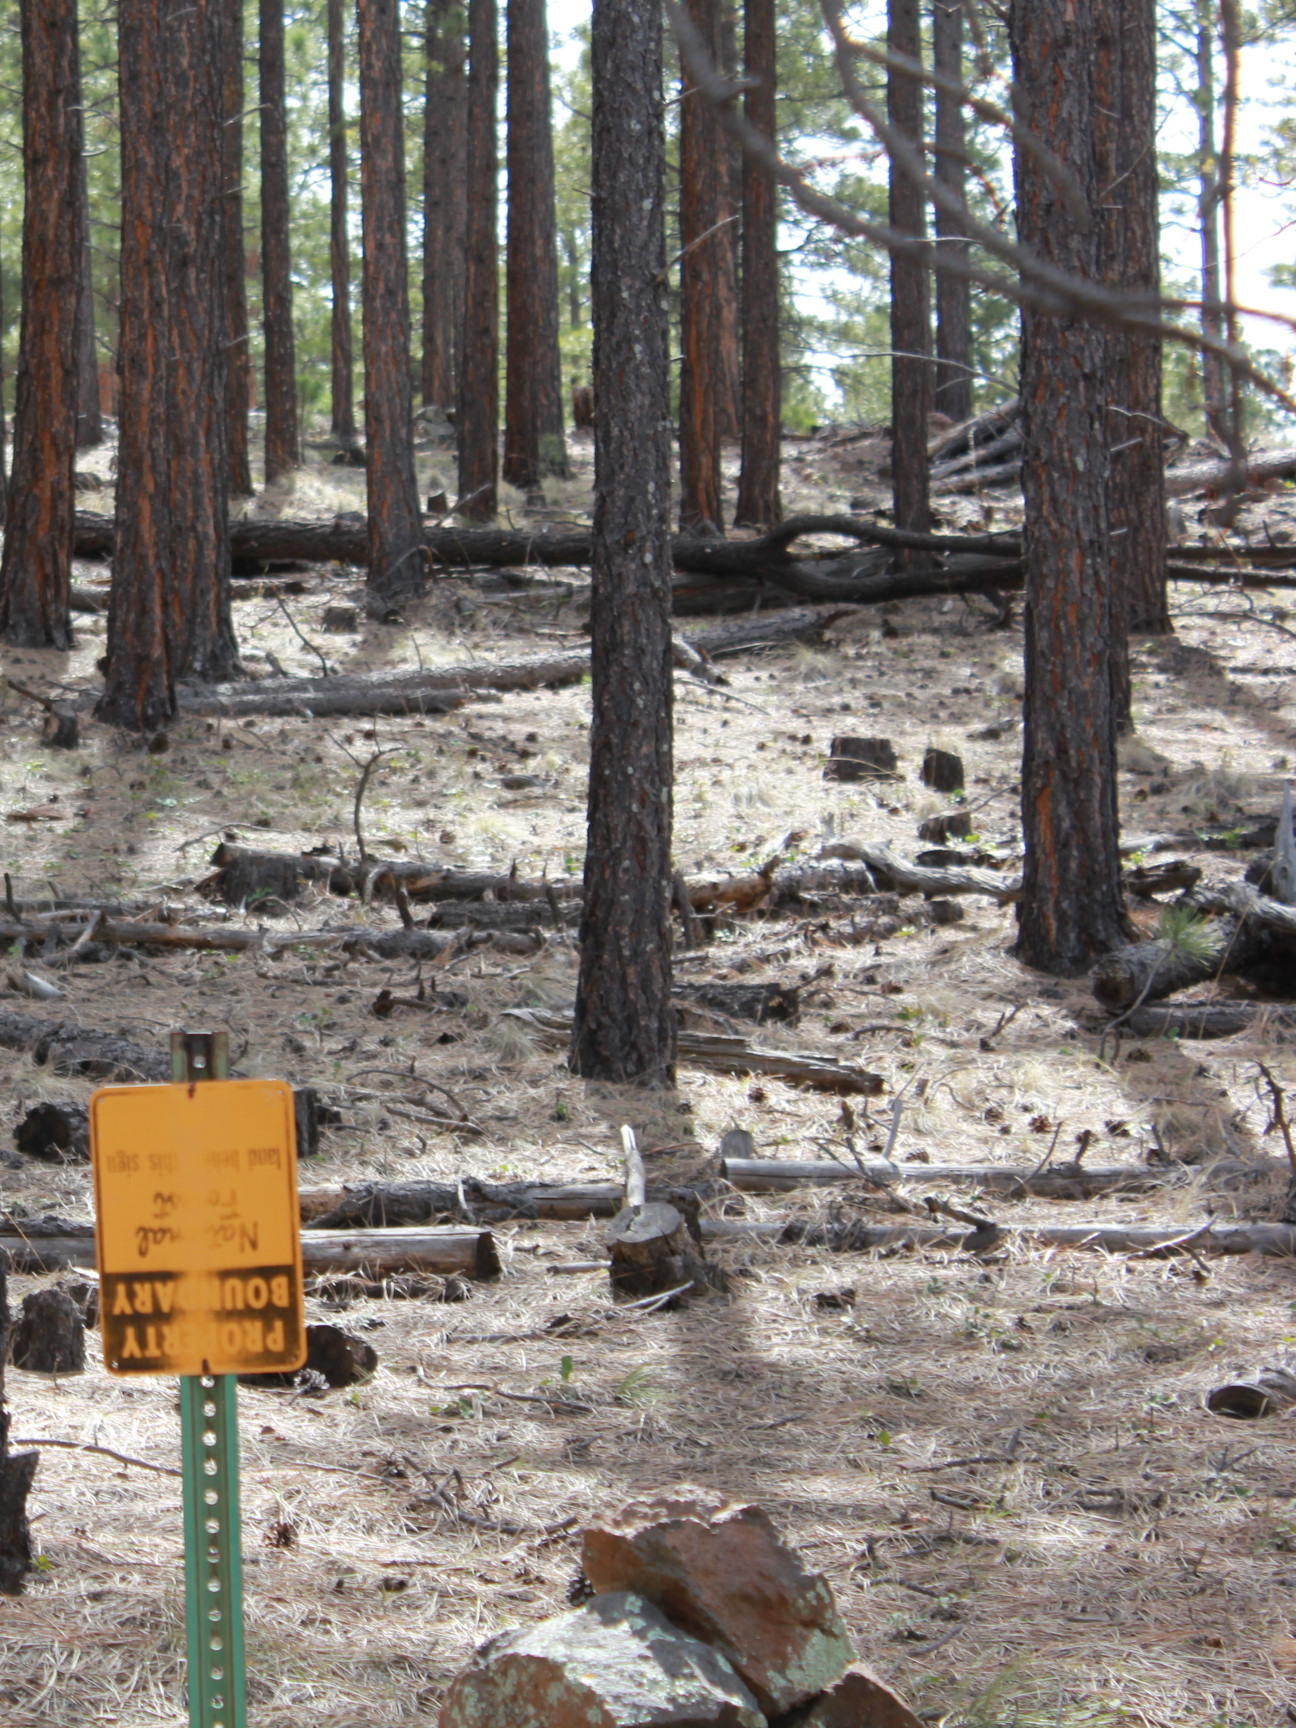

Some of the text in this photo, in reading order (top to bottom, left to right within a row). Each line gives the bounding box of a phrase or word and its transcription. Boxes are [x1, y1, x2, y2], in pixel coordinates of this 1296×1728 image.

[148, 1151, 181, 1176] his
[153, 1188, 241, 1219] Fost
[136, 1221, 259, 1258] Natnal
[112, 1275, 289, 1316] BOUARY
[121, 1319, 284, 1359] PRORTY
